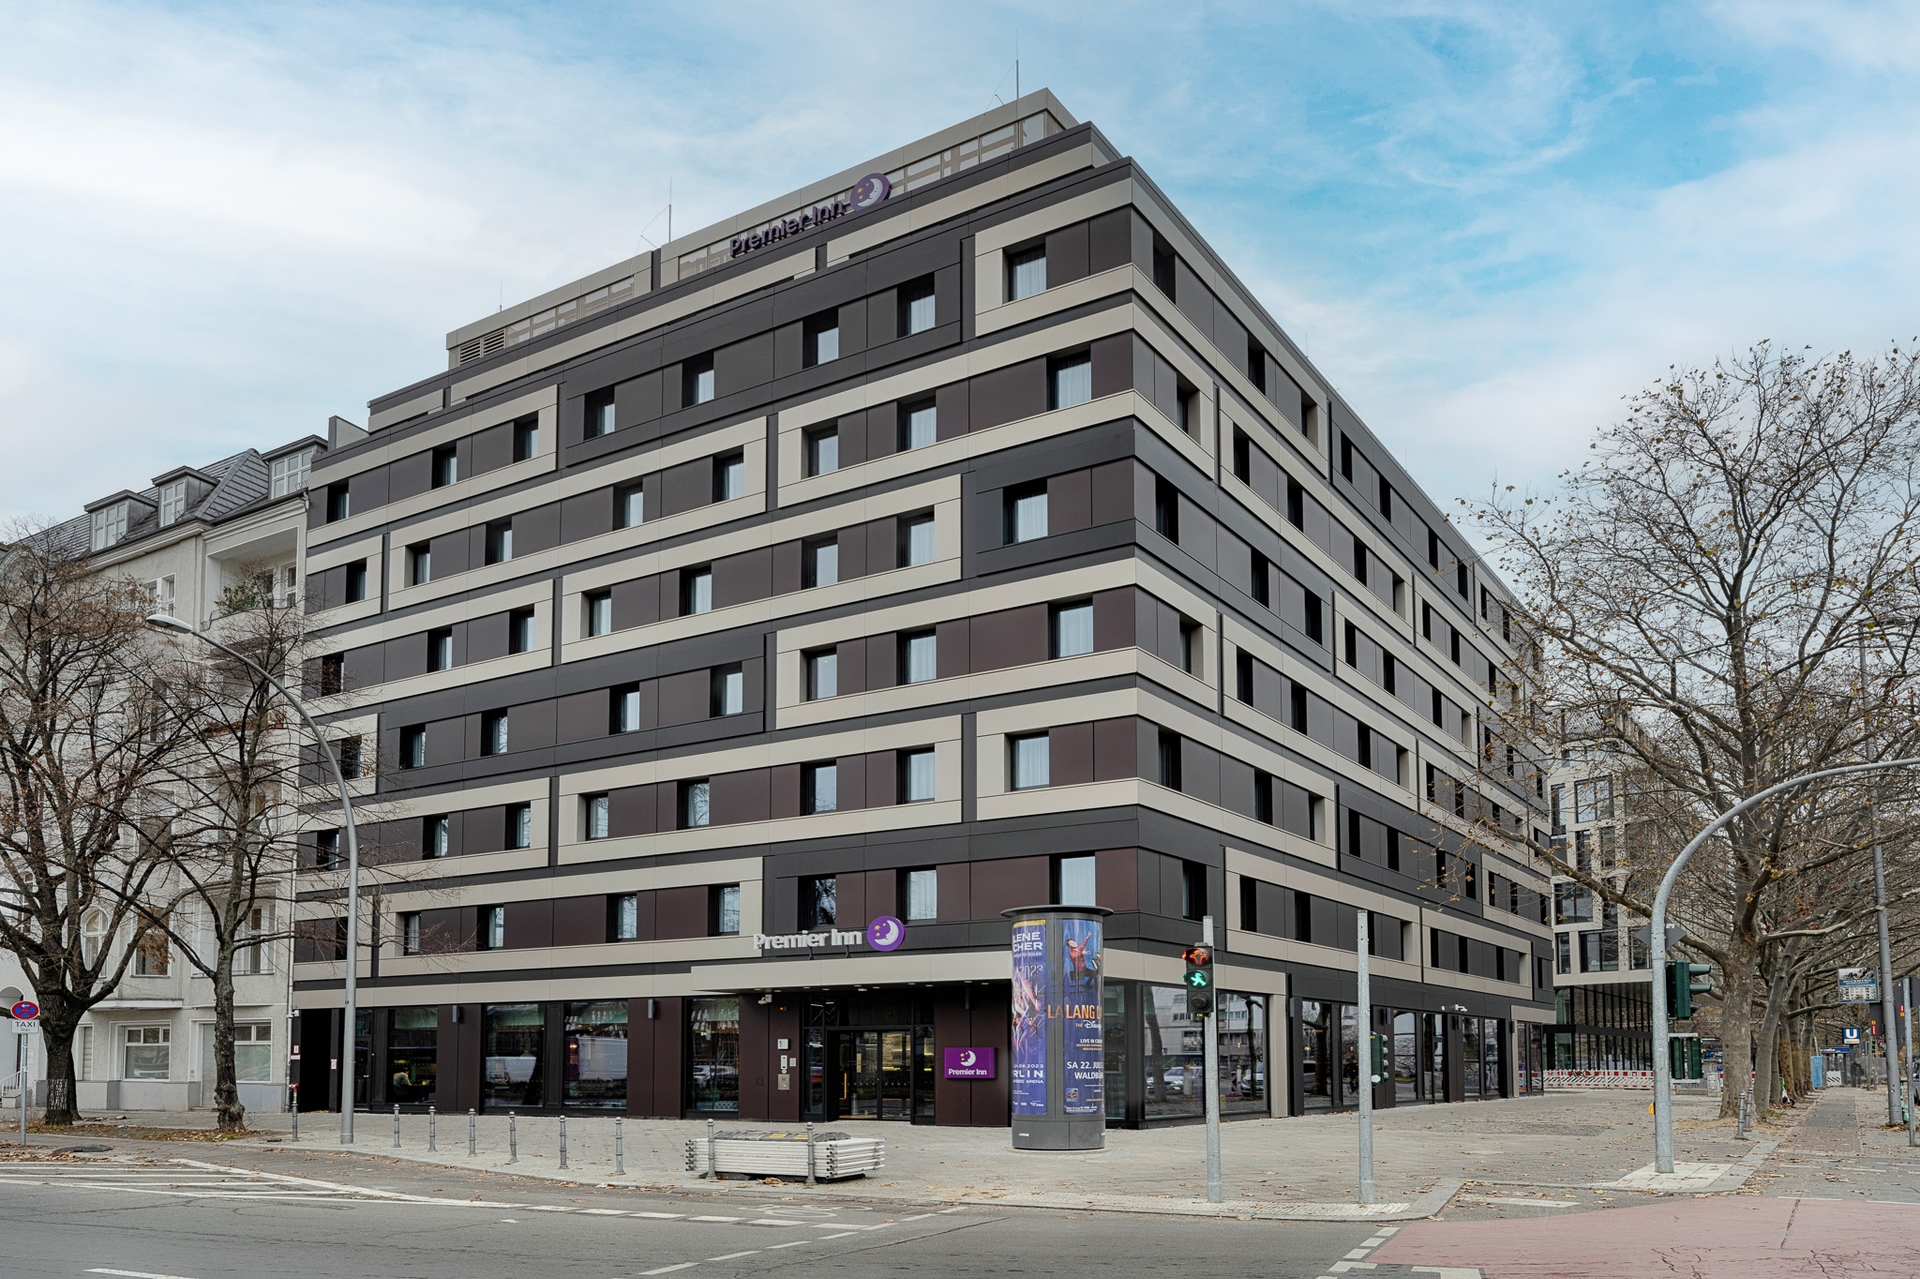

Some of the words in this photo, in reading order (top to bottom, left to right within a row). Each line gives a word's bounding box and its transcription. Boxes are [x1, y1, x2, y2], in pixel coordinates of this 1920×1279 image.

[730, 213, 810, 258] Premier
[812, 200, 845, 226] Inn
[753, 930, 829, 950] Premier
[831, 929, 863, 946] Inn
[1065, 1004, 1095, 1020] LANG
[1845, 1028, 1858, 1039] U
[1066, 1061, 1079, 1069] SA
[1080, 1061, 1092, 1069] 22.
[948, 1068, 975, 1076] Premier
[975, 1068, 988, 1076] Inn
